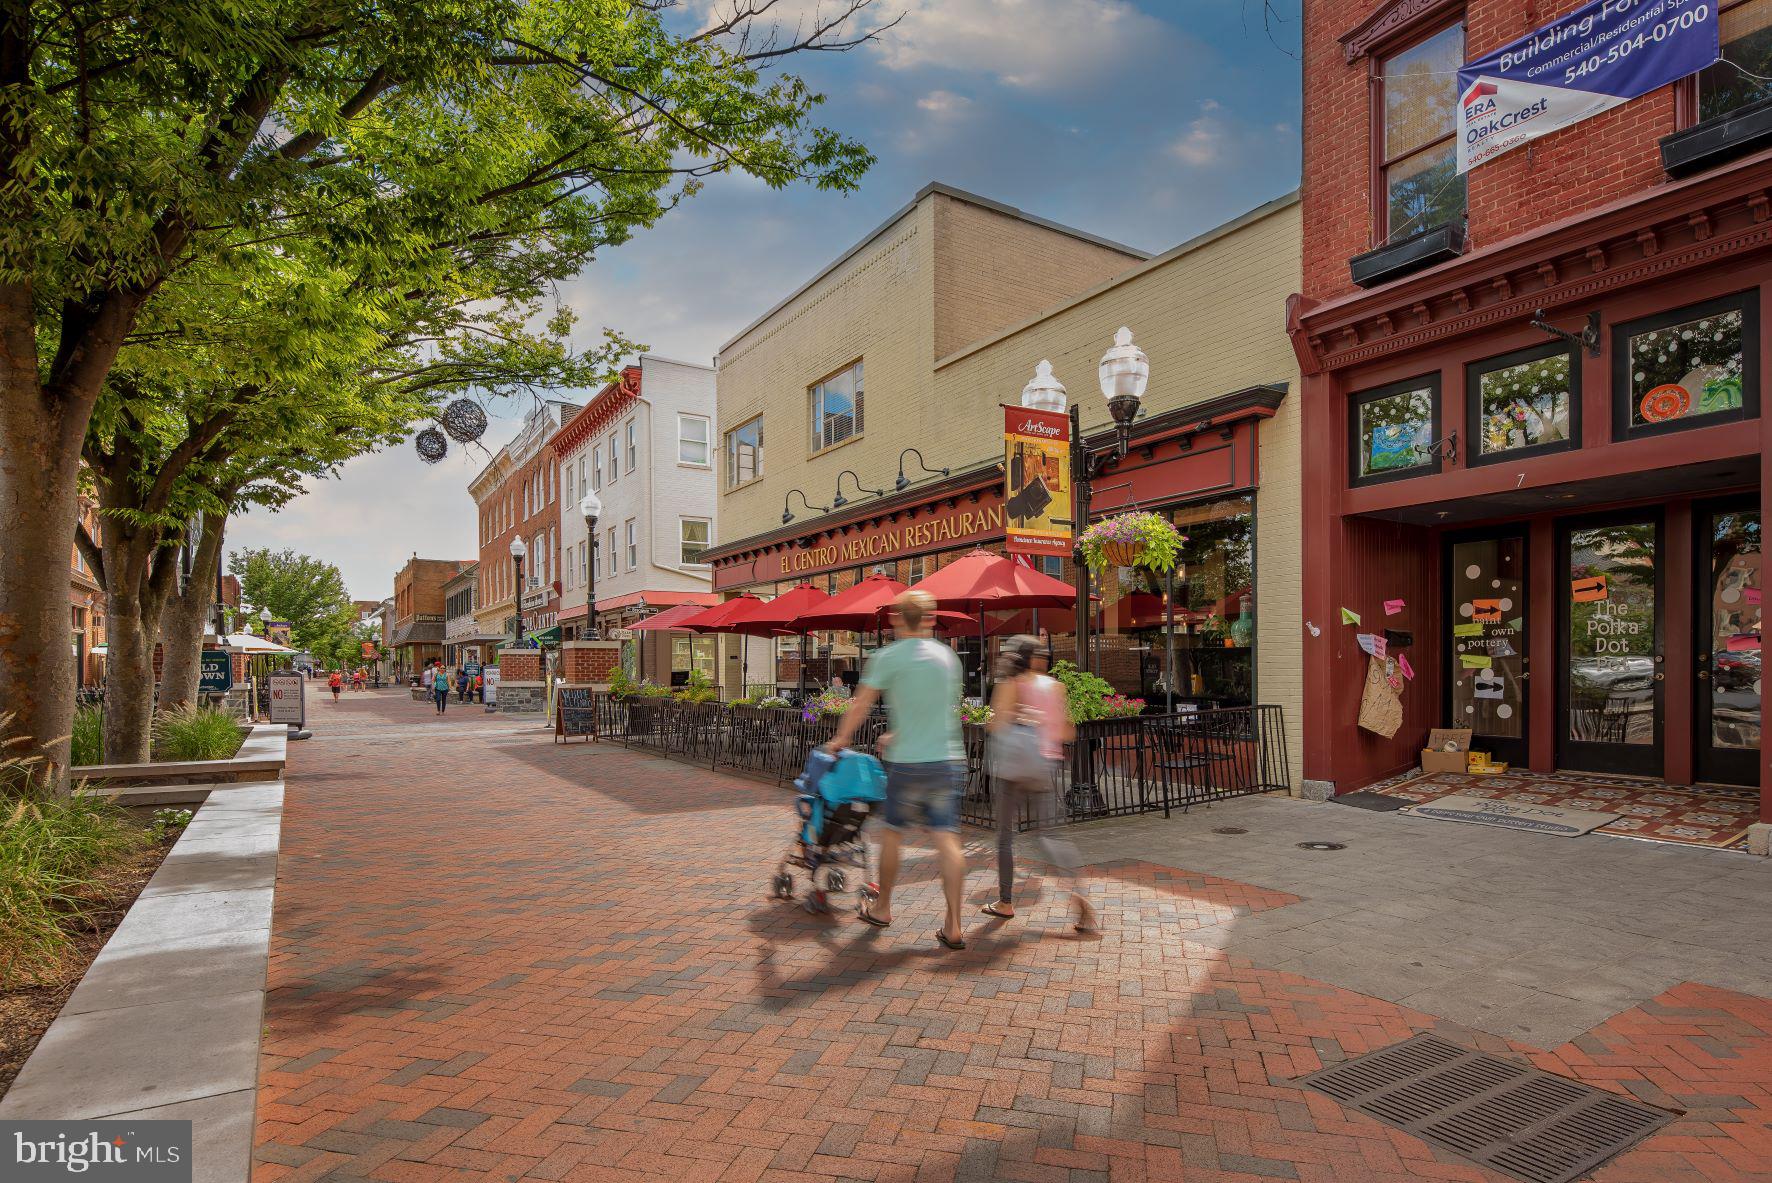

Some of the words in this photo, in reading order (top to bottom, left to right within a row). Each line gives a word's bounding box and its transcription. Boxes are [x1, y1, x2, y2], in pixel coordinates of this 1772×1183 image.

[1500, 15, 1594, 73] Building
[1601, 0, 1639, 21] Fo
[1527, 2, 1664, 77] Commercial/Residential
[1667, 0, 1689, 9] Sp
[1564, 4, 1708, 86] 540-504-0700
[1465, 98, 1496, 120] ERA
[1466, 97, 1547, 144] OakCrest
[1017, 419, 1061, 437] ArtScape
[1517, 473, 1525, 487] 7
[781, 555, 791, 574] EL
[793, 545, 838, 571] CENTRO
[841, 529, 901, 563] MEXICAN
[1593, 600, 1628, 615] The
[1491, 628, 1514, 636] own
[1586, 619, 1638, 635] Polka
[1467, 639, 1509, 650] pottery
[1595, 637, 1629, 653] Dot
[201, 663, 219, 671] LD
[273, 689, 283, 699] NO
